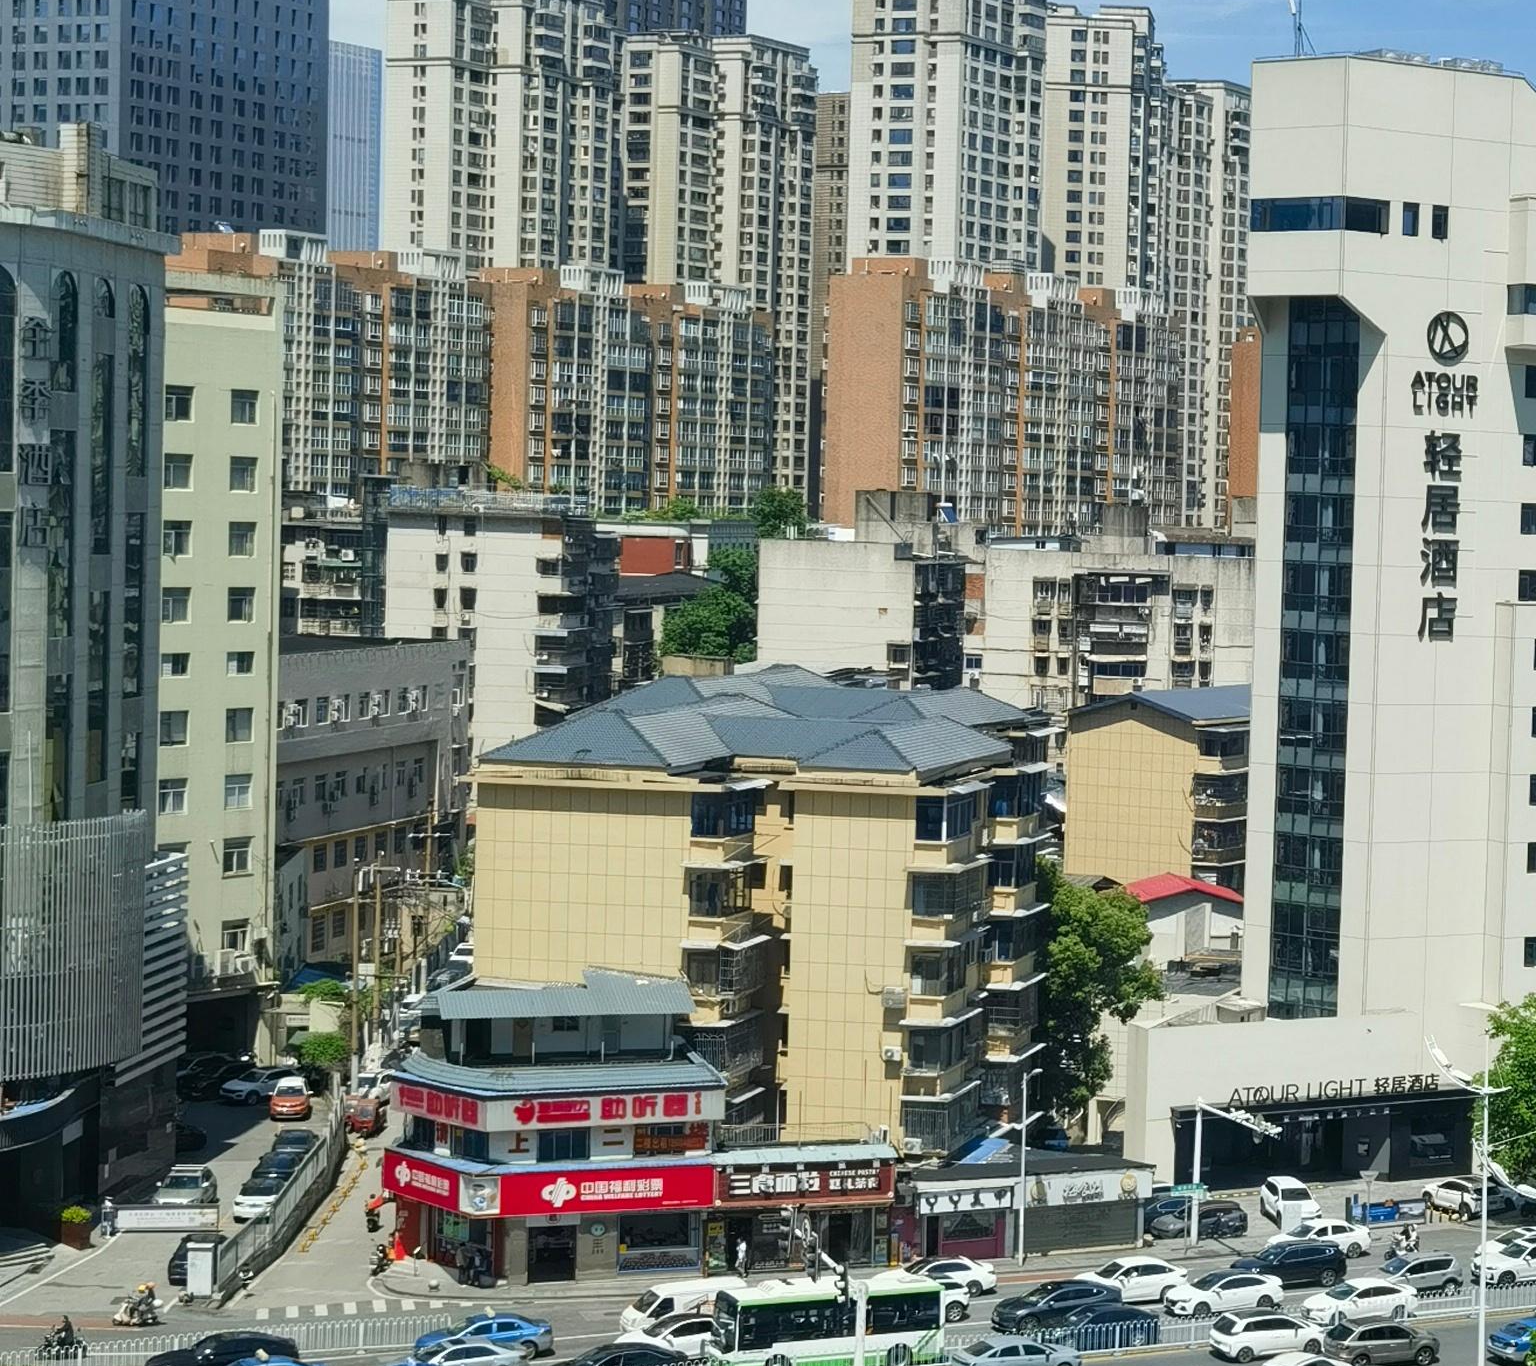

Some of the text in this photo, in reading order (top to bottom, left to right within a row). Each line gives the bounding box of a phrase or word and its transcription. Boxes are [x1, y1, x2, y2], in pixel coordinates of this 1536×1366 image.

[1411, 371, 1479, 393] ATOUR
[1412, 392, 1478, 416] LIGHT
[18, 316, 52, 547] 全季酒店
[1418, 430, 1462, 642] 轻居酒店
[1228, 1078, 1367, 1107] ATOUR LIGHT
[1374, 1074, 1440, 1095] 轻居酒店
[600, 1093, 688, 1120] 助听器
[581, 1178, 663, 1194] 中国福利彩票
